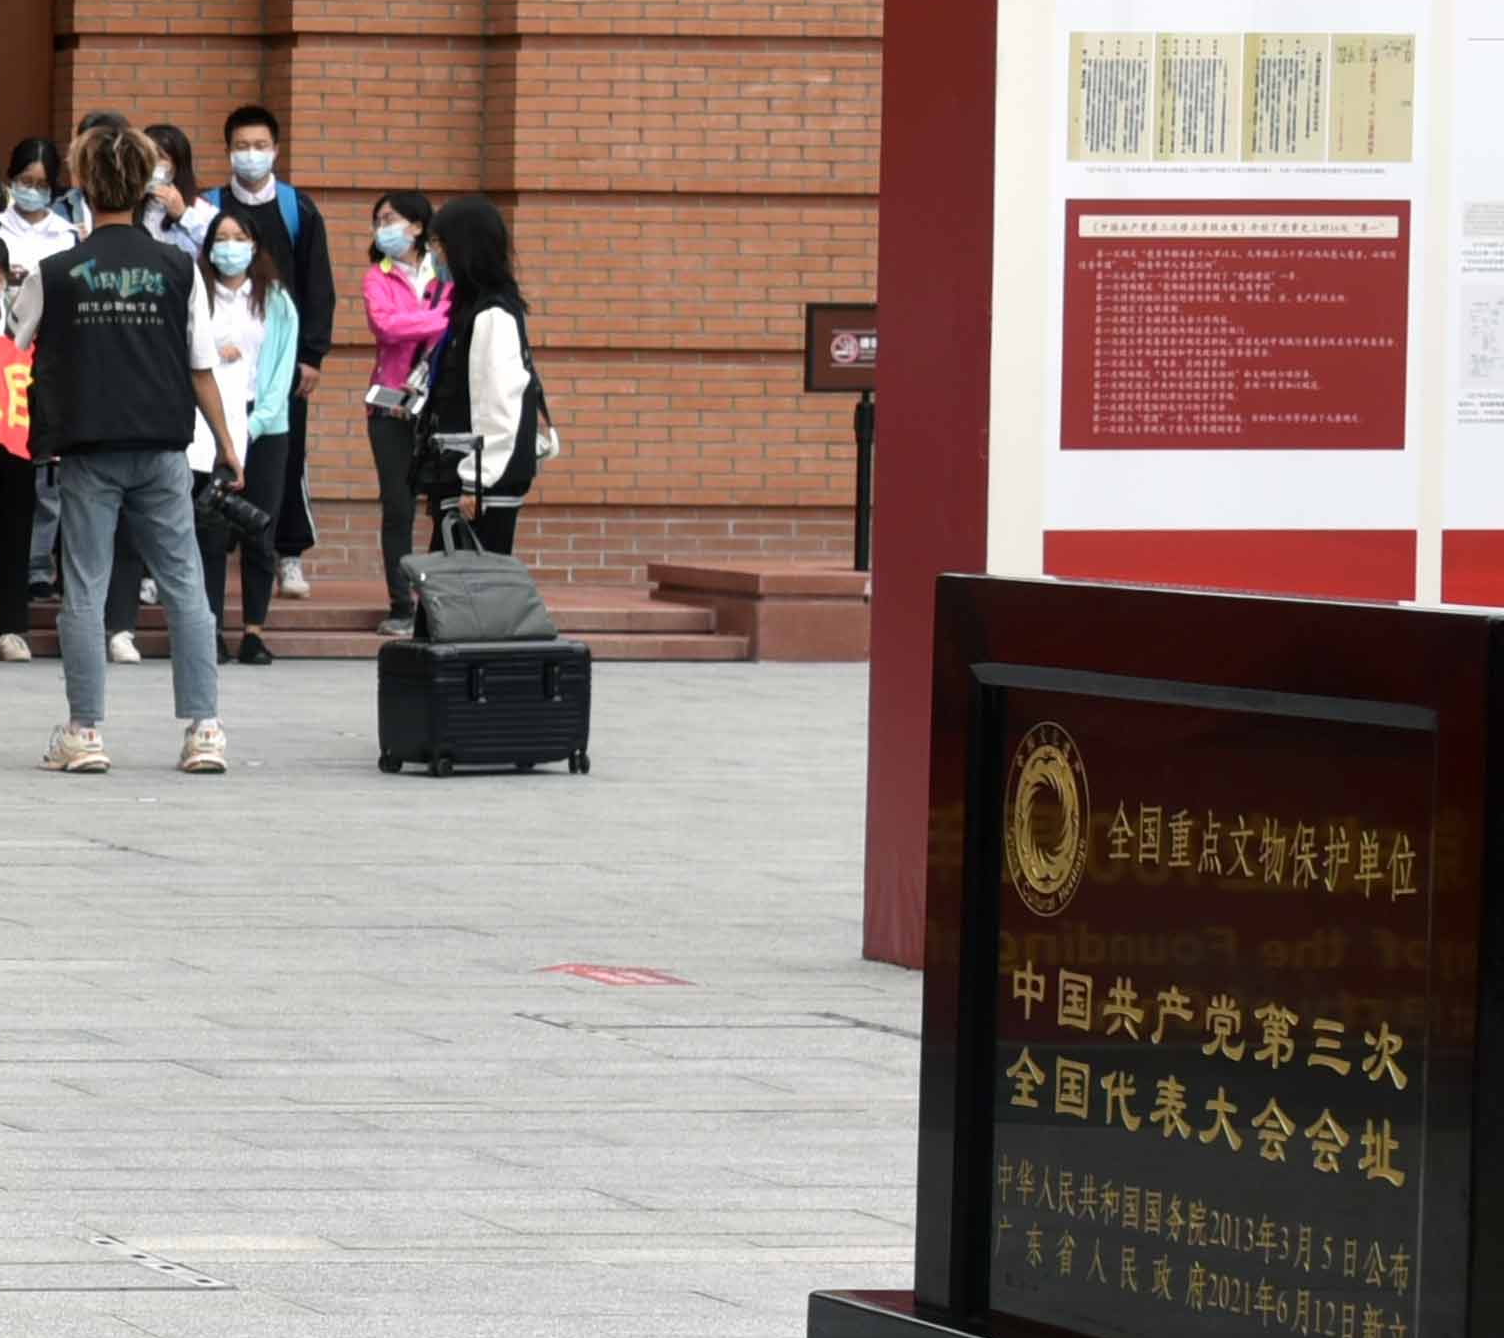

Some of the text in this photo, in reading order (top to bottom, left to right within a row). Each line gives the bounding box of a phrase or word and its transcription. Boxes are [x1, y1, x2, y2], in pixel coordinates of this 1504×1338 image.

[1106, 798, 1418, 902] 全国重点文物保护单位
[1012, 960, 1408, 1091] 中国共产党第三次
[1005, 1045, 1407, 1189] 全国代表大会会址
